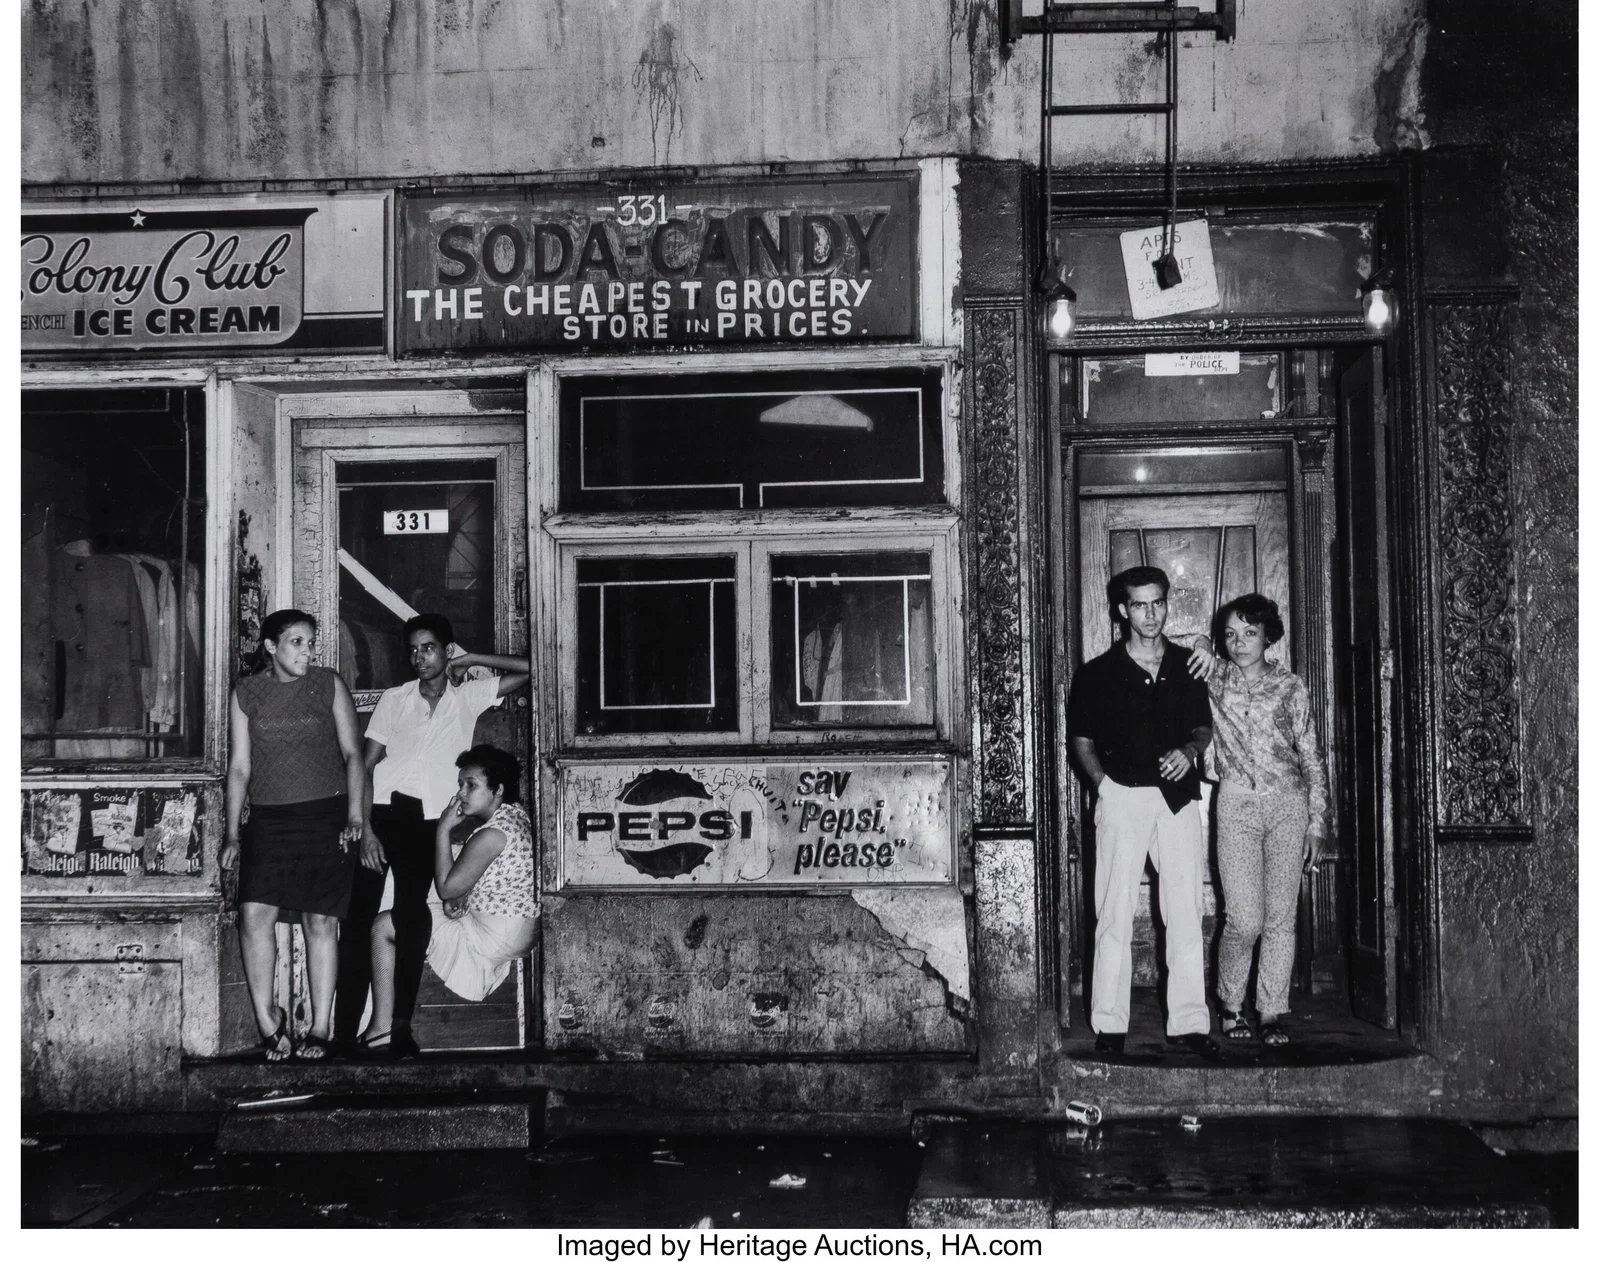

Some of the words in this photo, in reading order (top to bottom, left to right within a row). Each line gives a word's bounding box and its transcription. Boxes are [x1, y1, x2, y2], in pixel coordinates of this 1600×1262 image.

[436, 210, 887, 286] SODA-CANDY
[153, 230, 292, 305] Club
[406, 288, 484, 322] THE
[503, 280, 703, 317] CHEAPEST
[715, 278, 873, 311] GROCERY
[21, 314, 66, 331] ENCH
[73, 309, 133, 337] ICE
[145, 305, 281, 335] CREAM
[563, 311, 669, 341] STORE
[686, 318, 710, 334] IN
[717, 308, 870, 338] PRICES.
[1190, 359, 1223, 369] POLICE
[396, 512, 430, 530] 331
[93, 793, 126, 803] Smoke
[797, 771, 852, 799] say
[577, 811, 752, 841] PEPSI
[90, 852, 140, 874] Raleigh
